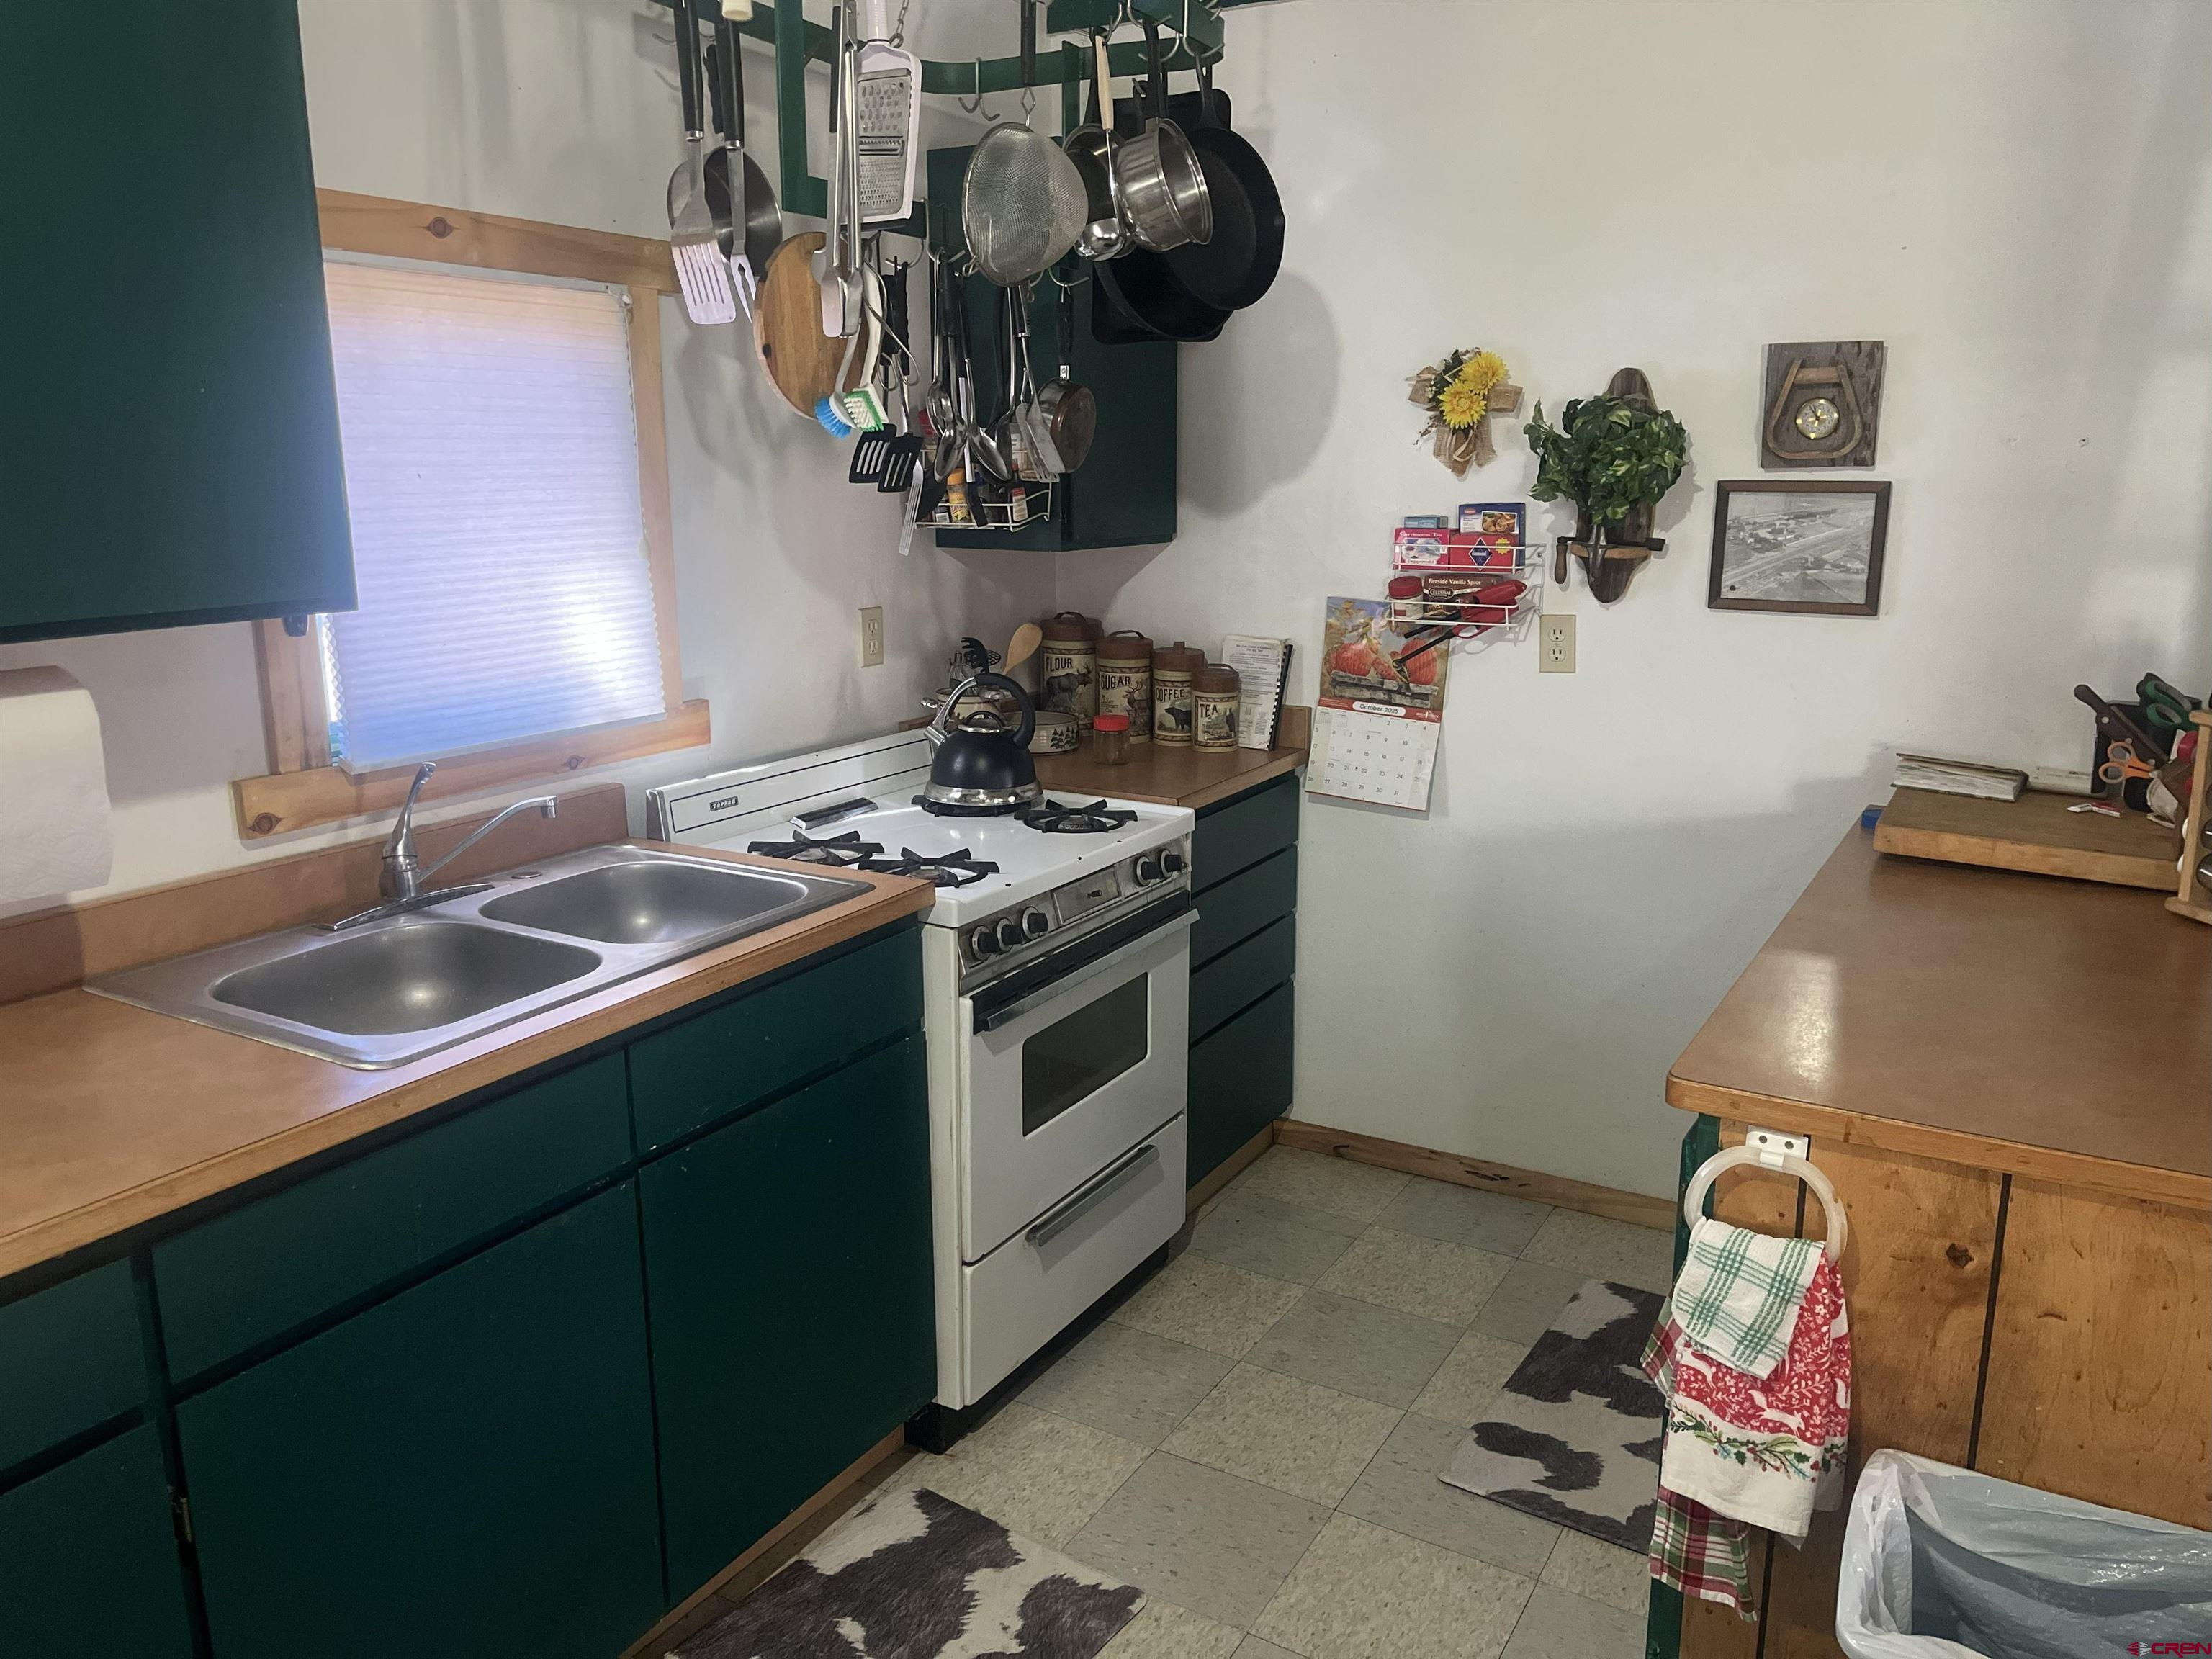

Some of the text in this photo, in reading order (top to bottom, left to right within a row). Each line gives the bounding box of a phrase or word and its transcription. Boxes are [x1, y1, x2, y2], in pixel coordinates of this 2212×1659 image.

[1046, 656, 1072, 672] FLOUR
[1100, 674, 1131, 690] SUGAR
[1156, 687, 1184, 703] COFFEE
[1199, 703, 1218, 718] TEA
[1359, 703, 1383, 712] October
[712, 799, 736, 809] TAPPAN
